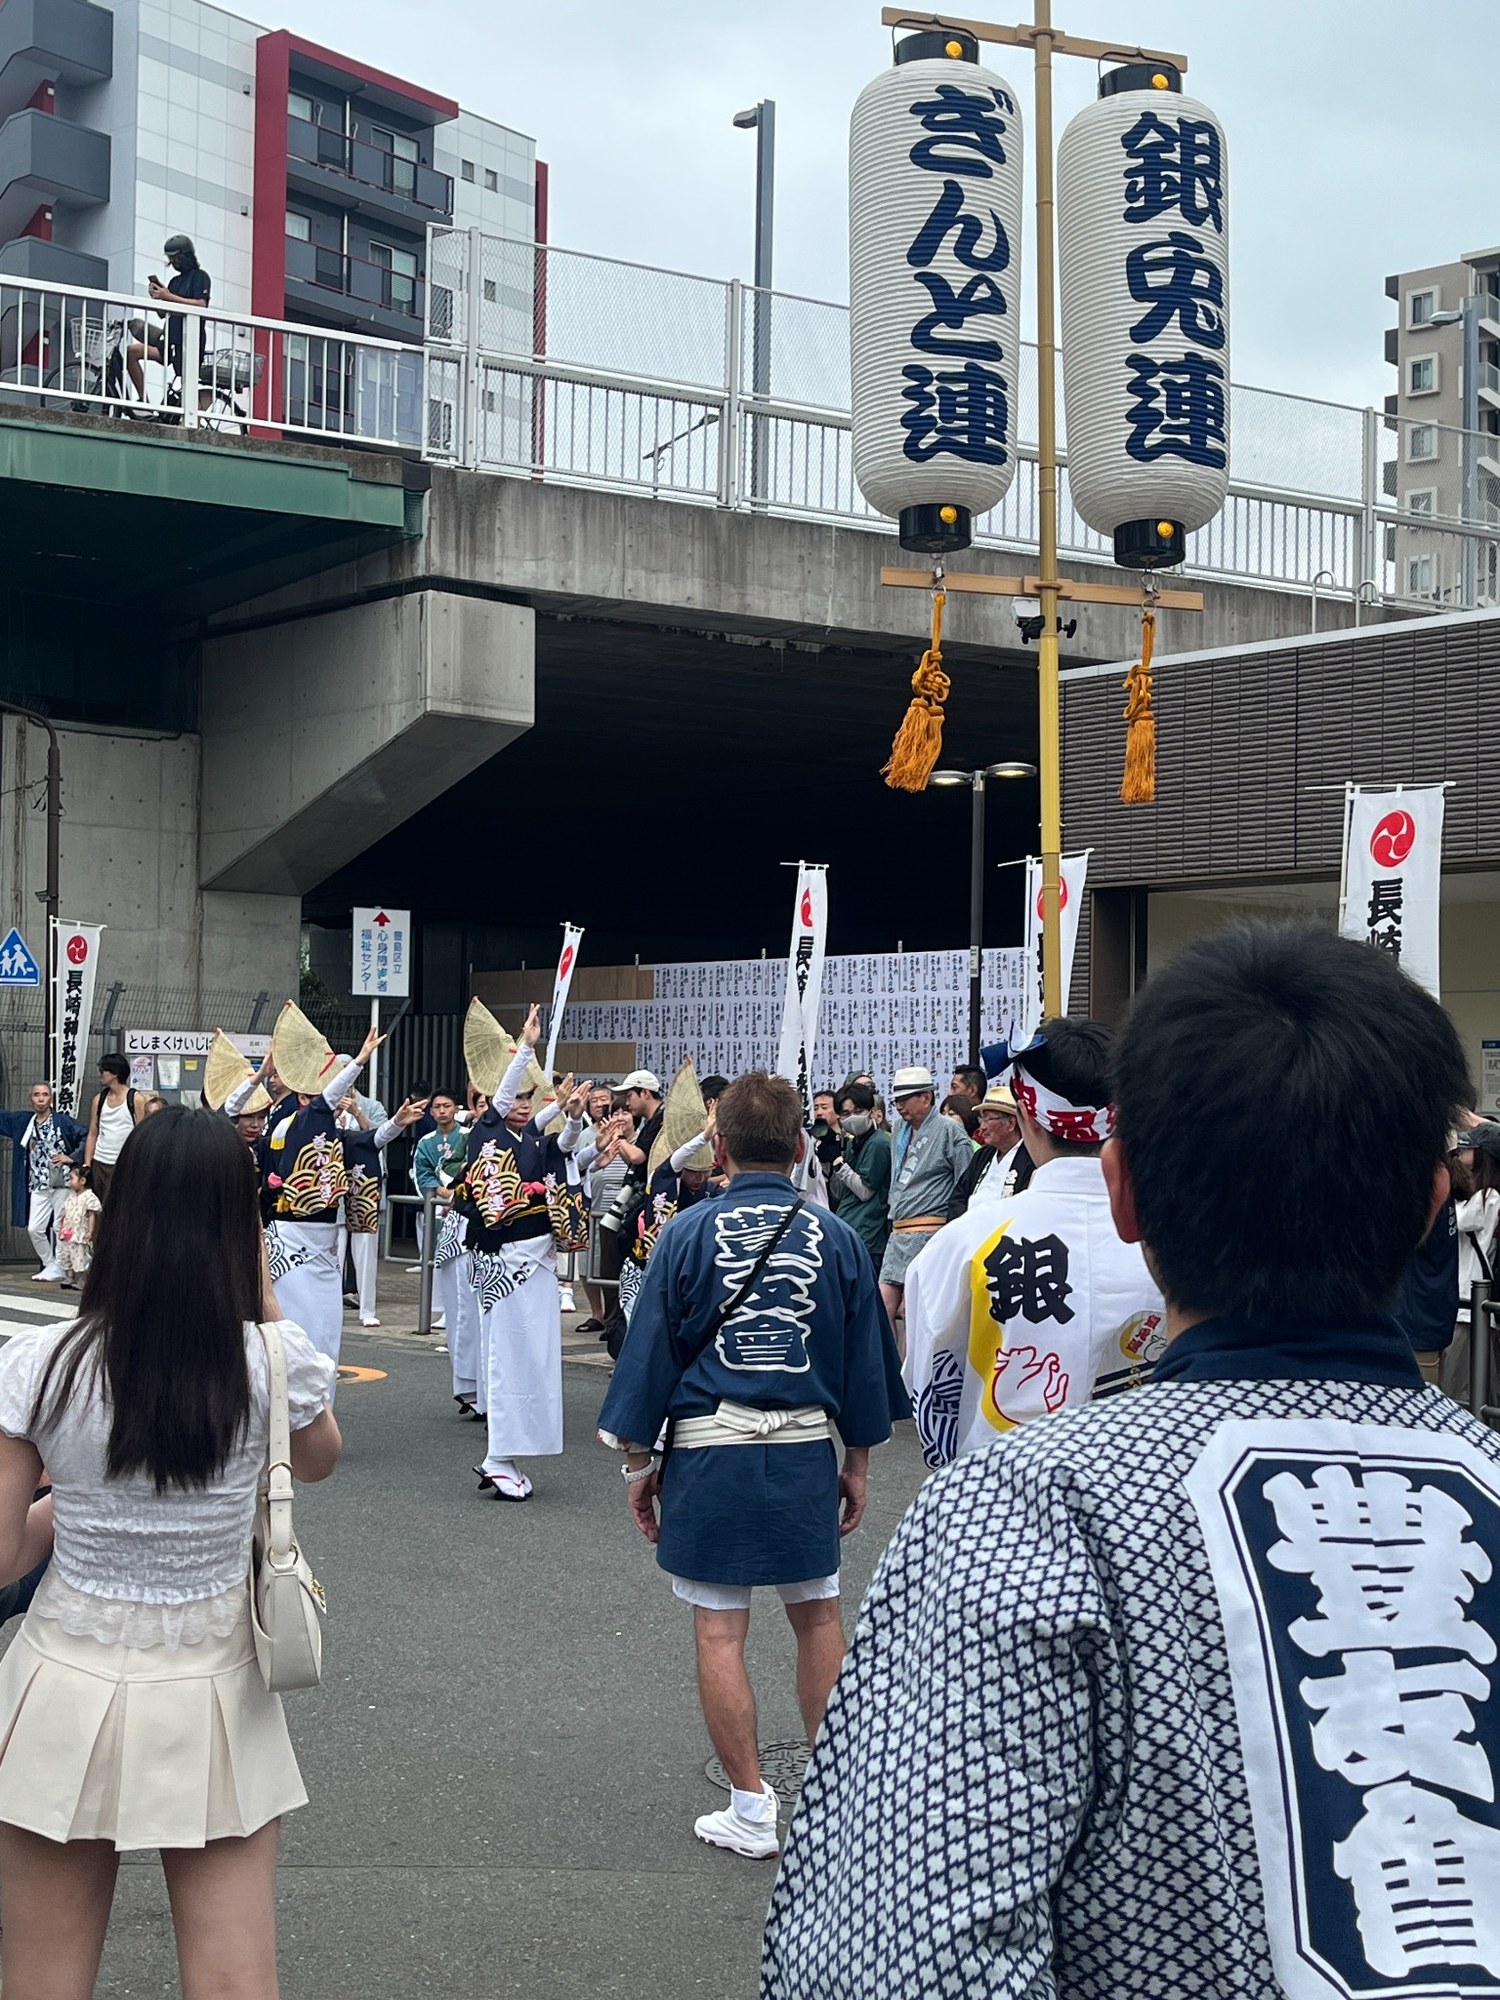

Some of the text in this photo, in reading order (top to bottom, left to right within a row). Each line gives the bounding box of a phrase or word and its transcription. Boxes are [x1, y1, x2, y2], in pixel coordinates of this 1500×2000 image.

[902, 85, 1013, 465] ぎんと連
[360, 929, 372, 992] 福祉センター
[58, 970, 83, 1116] 長崎神社御祭
[983, 1233, 1076, 1325] 銀
